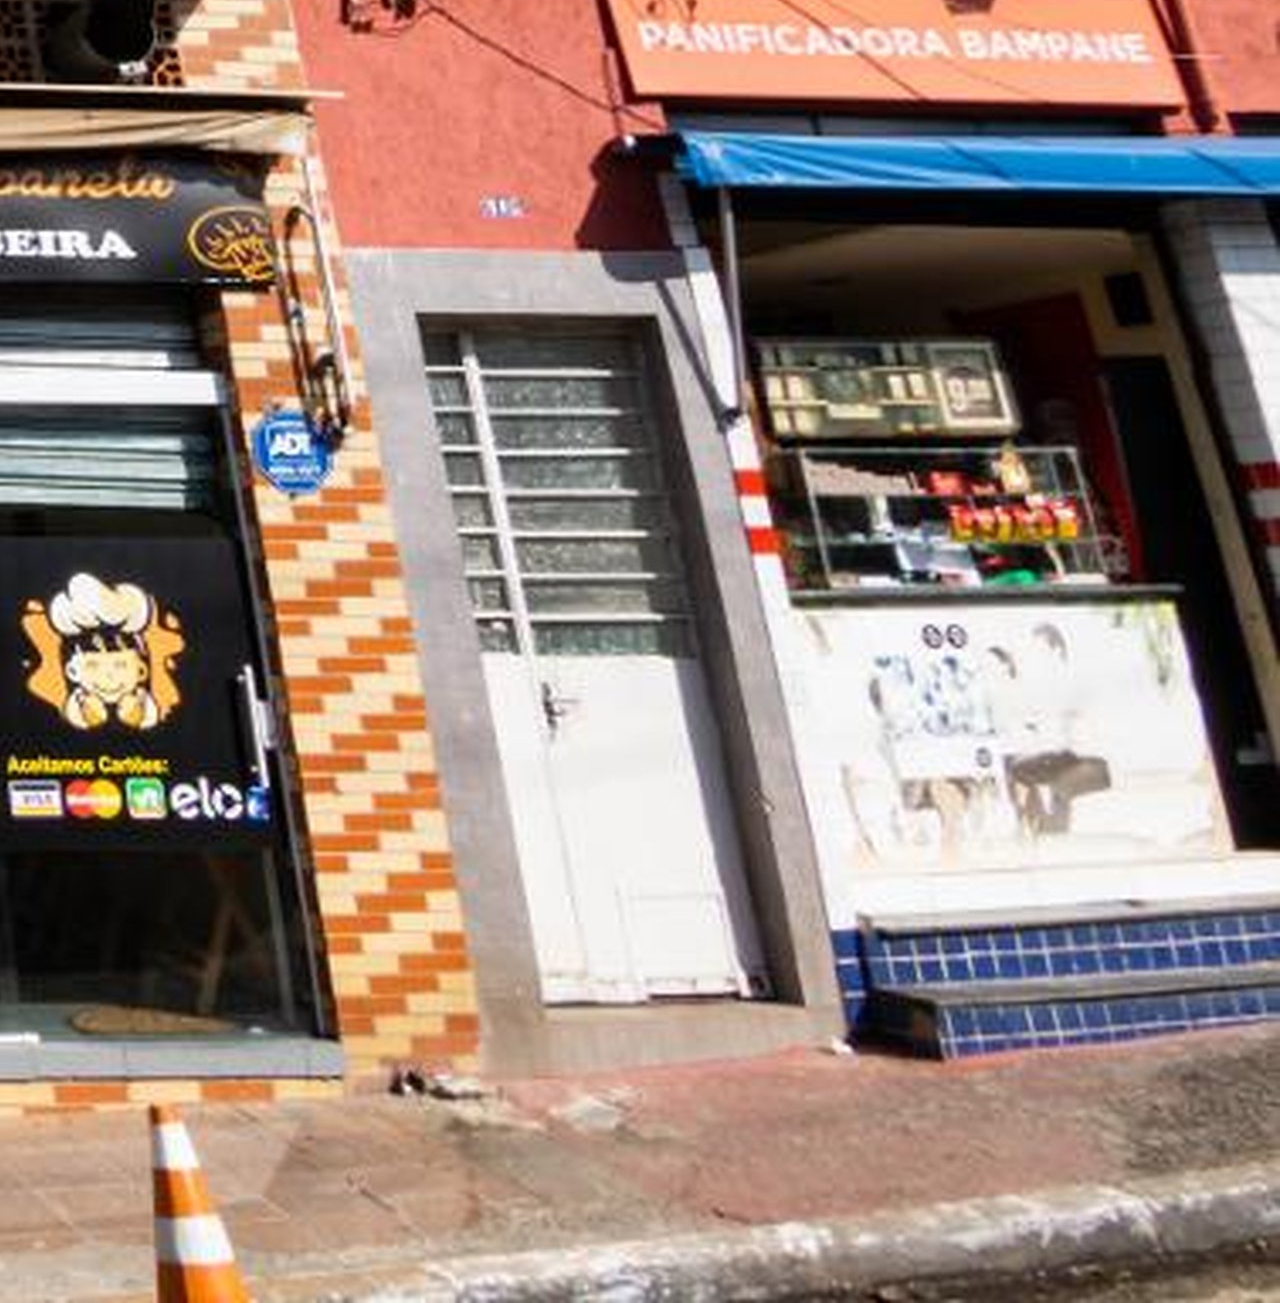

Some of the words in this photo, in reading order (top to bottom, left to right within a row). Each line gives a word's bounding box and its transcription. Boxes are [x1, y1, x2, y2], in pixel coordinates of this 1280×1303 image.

[638, 21, 951, 58] PANIFICADORA
[958, 28, 1153, 63] BAMPANE
[7, 754, 95, 776] Aceitamos
[169, 775, 243, 820] elo
